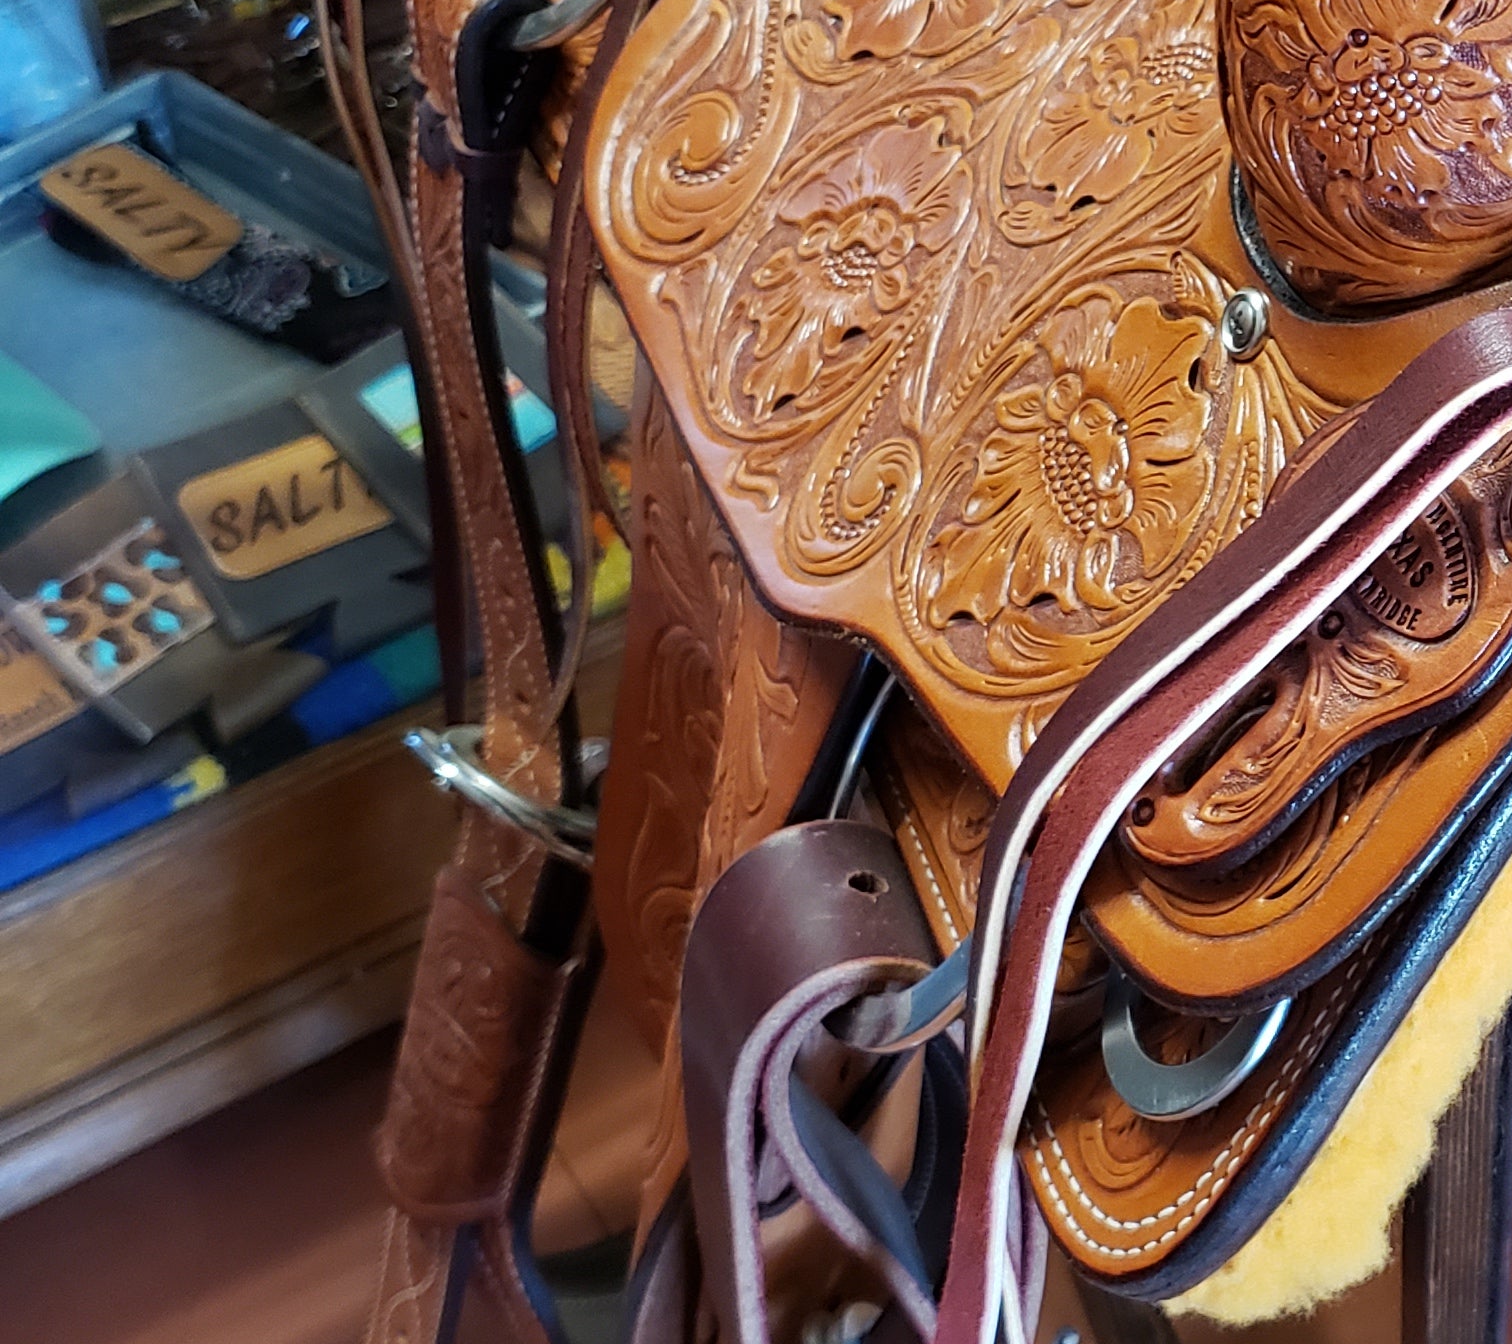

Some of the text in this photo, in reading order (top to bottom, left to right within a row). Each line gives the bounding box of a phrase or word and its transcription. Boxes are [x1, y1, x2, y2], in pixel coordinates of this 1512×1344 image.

[61, 163, 230, 255] SALTY
[208, 457, 372, 553] SALT
[1386, 530, 1434, 589] XAS
